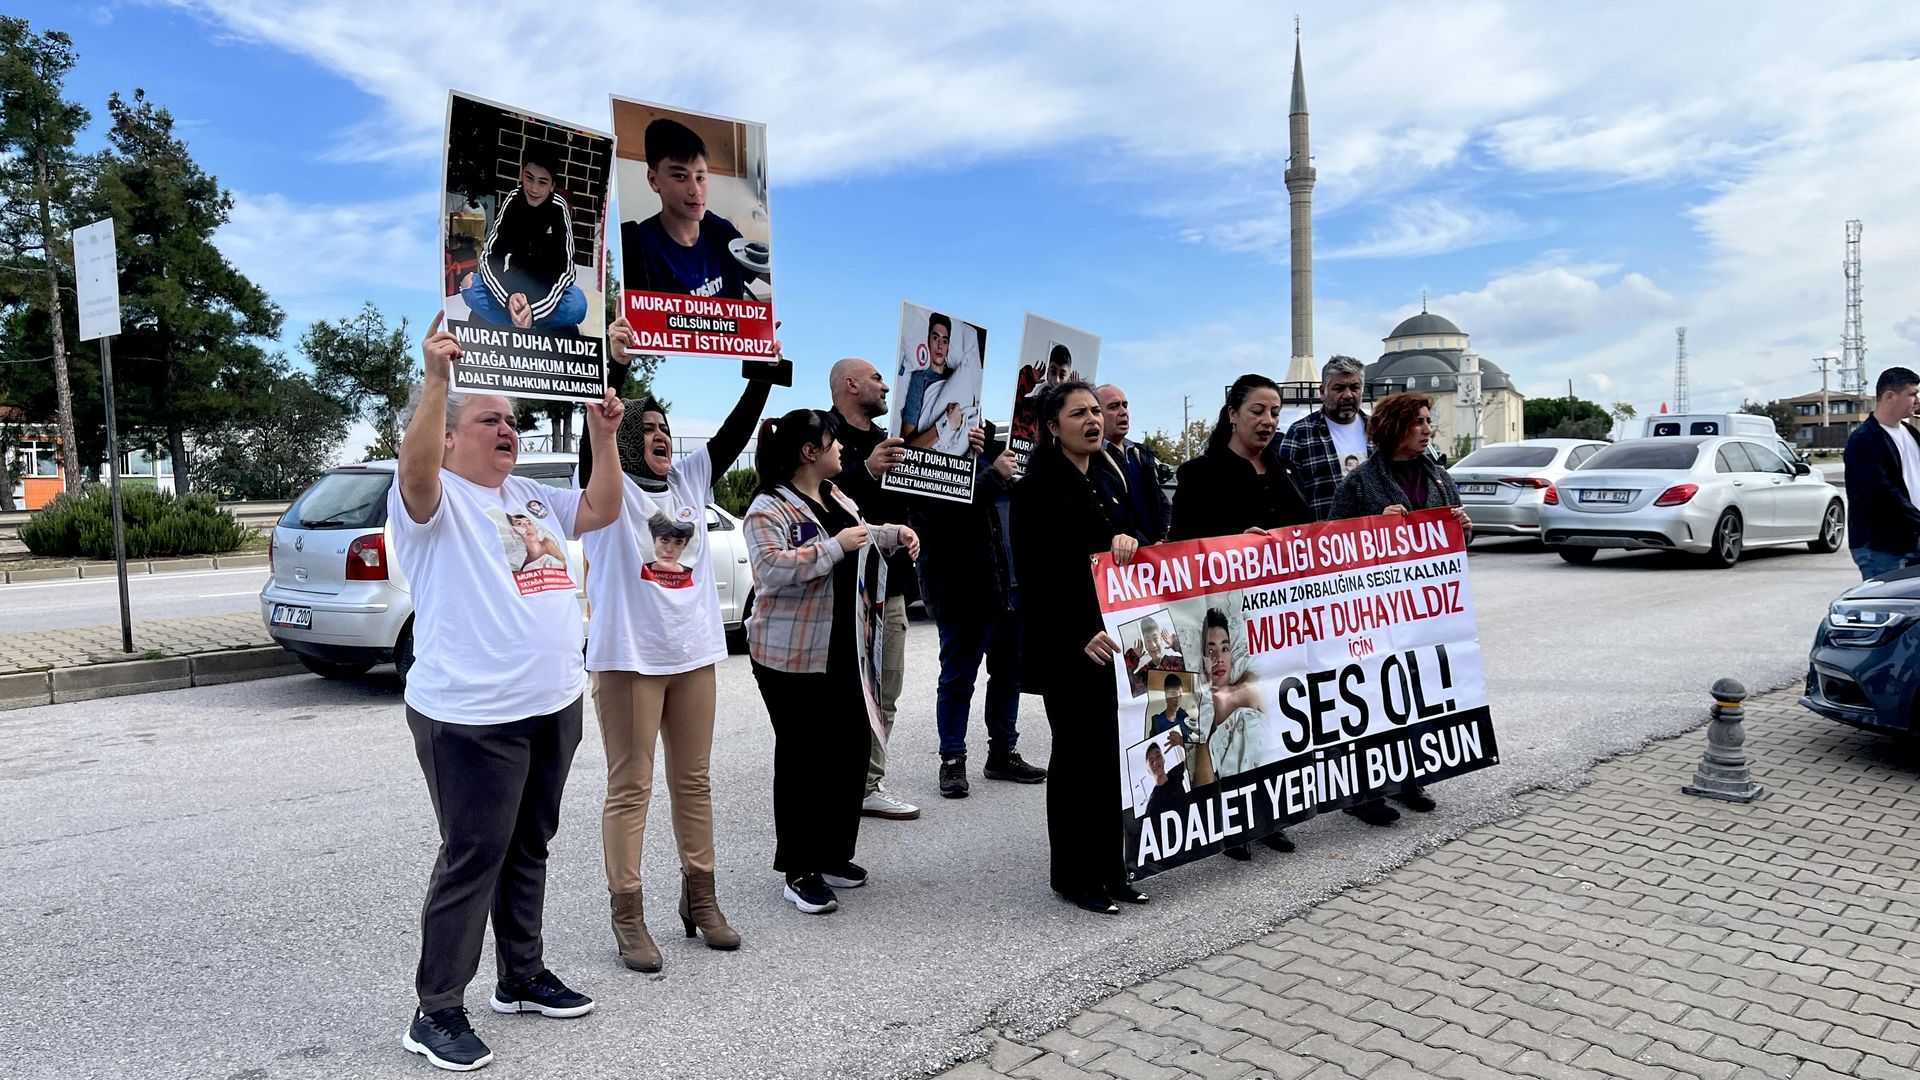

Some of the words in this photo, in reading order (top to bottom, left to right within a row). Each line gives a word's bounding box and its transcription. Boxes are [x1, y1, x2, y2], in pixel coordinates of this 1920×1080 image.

[631, 295, 682, 313] MURAT
[685, 301, 724, 317] DUHA
[726, 304, 767, 320] YILDIZ
[669, 315, 711, 331] GÜLSÜN
[713, 318, 735, 332] DİYE
[455, 326, 509, 347] MURAT
[512, 333, 552, 351] DUHA
[555, 338, 598, 357] YILDIZ
[632, 331, 692, 349] ADALET
[695, 331, 773, 354] İSTİYORUZ
[510, 355, 565, 373] MAHKUM
[567, 361, 599, 377] KALDI
[458, 371, 500, 386] ADALET
[502, 375, 550, 390] MAHKUM
[552, 380, 603, 395] KALMASIN
[1012, 439, 1035, 451] MURA
[893, 449, 924, 462] URAT
[925, 453, 947, 467] DUHA
[948, 458, 972, 472] YILDIZ
[891, 463, 919, 475] ATAĞA
[921, 468, 952, 481] MAHKUM
[952, 474, 971, 485] KALDI
[887, 475, 914, 487] ADALET
[913, 480, 941, 491] MAHKUM
[942, 485, 971, 497] KALMASIN
[1585, 491, 1592, 500] 17
[1106, 555, 1193, 604] AKRAN
[1195, 529, 1315, 588] ZORBALIĞI
[1318, 531, 1359, 567] SON
[1360, 519, 1449, 561] BULSUN
[516, 570, 542, 581] MURAT
[1241, 588, 1287, 612] AKRAN
[1290, 575, 1364, 602] ZORBALIĞINA
[1403, 558, 1462, 582] KALMA!
[286, 608, 295, 622] TV
[297, 609, 310, 623] 200
[1246, 602, 1325, 656] MURAT
[1348, 636, 1375, 661] İÇİN
[1278, 663, 1370, 754] SES
[1380, 644, 1457, 726] OL!
[1137, 784, 1257, 868] ADALET
[1263, 743, 1360, 820] YERİNİ
[1365, 721, 1484, 790] BULSUN
